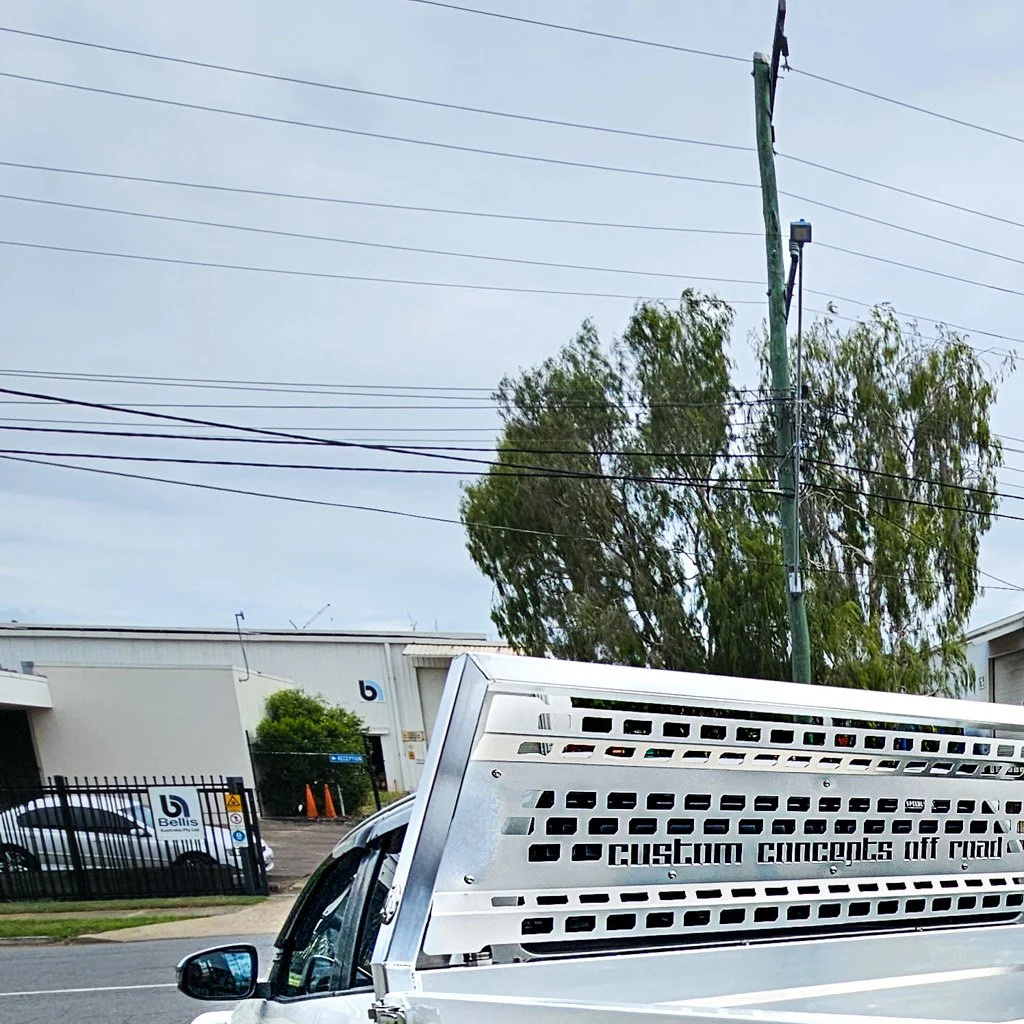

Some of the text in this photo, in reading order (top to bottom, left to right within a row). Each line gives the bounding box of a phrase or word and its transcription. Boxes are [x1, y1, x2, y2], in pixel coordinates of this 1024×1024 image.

[158, 817, 199, 827] Bellis
[608, 836, 1003, 868] custom concepts off road
